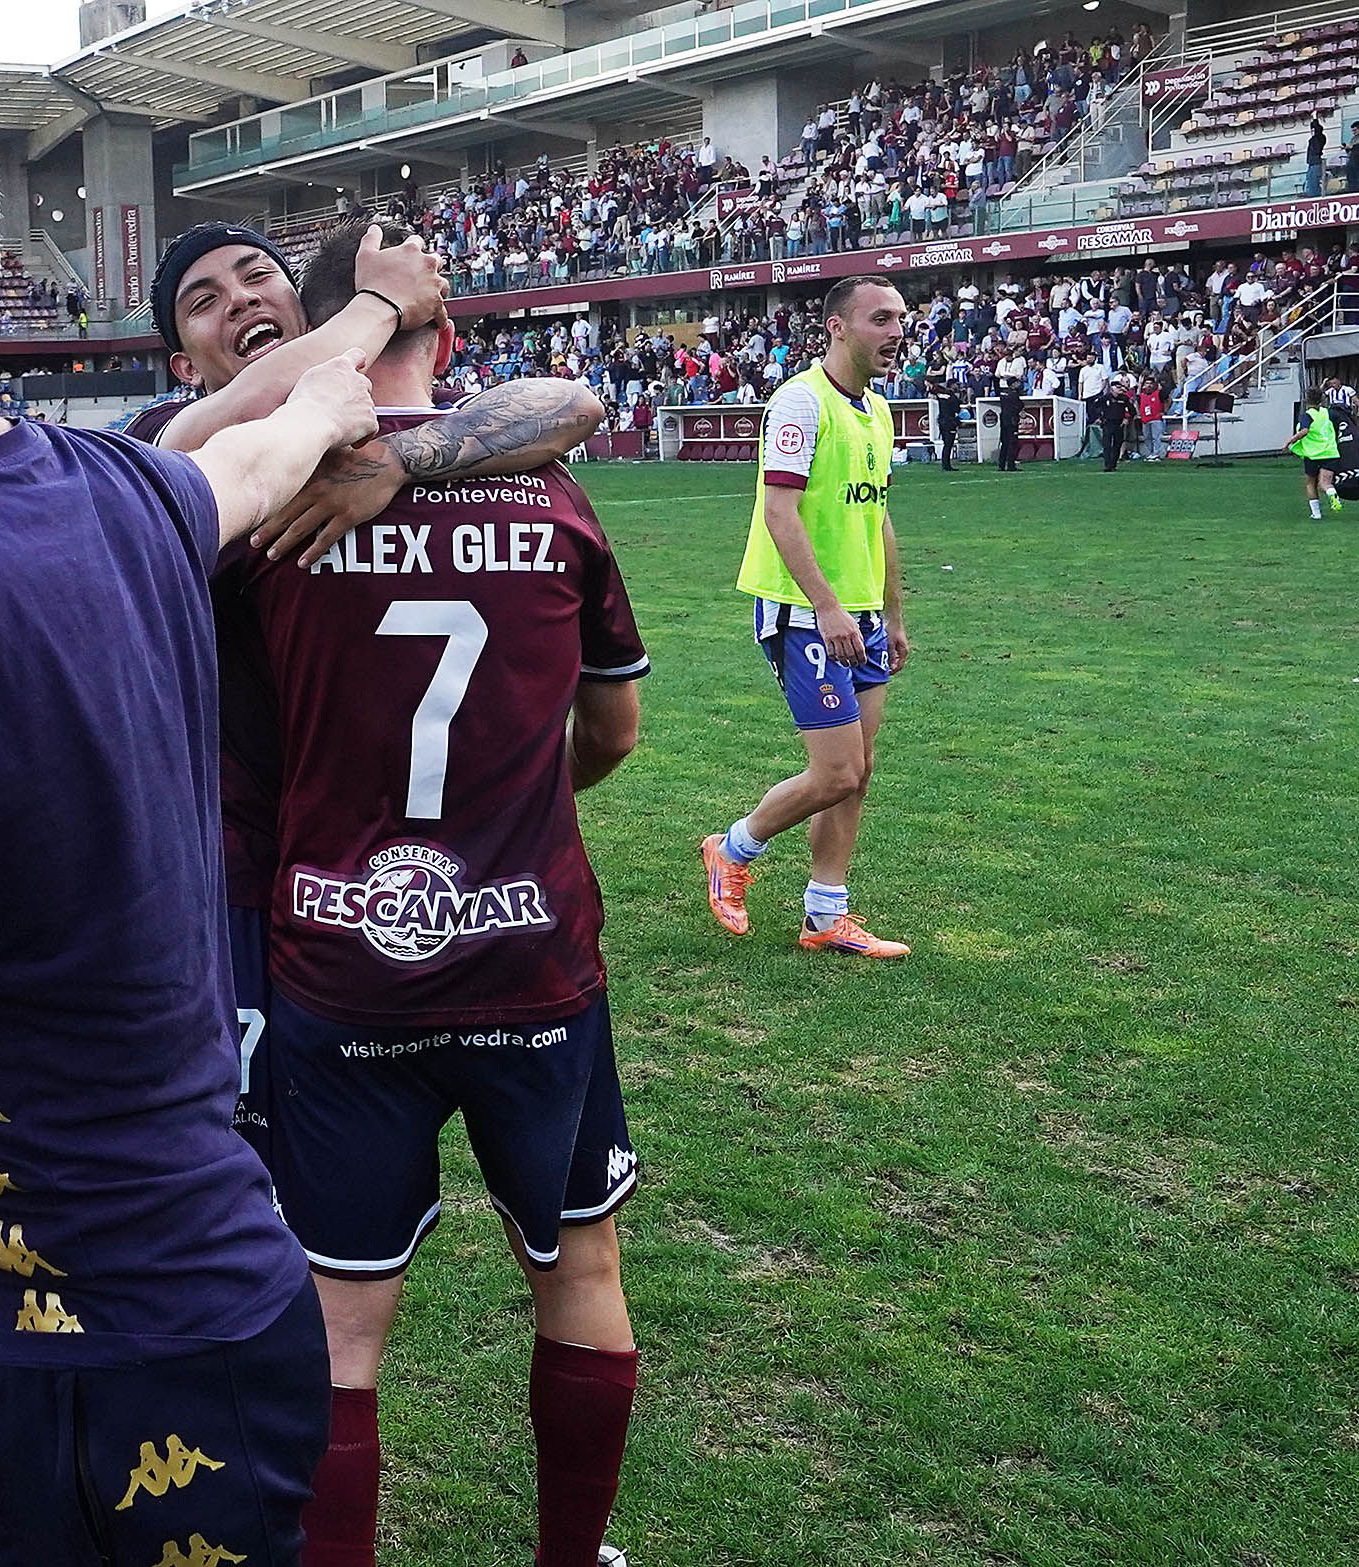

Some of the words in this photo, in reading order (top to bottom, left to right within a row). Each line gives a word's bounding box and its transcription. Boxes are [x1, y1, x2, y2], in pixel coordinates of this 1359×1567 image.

[126, 209, 139, 266] Pontevedra
[1077, 228, 1154, 249] PESCAMAR
[910, 248, 974, 268] PESCAMAR
[128, 276, 140, 307] Diario
[412, 486, 552, 508] Pontevedra
[311, 524, 433, 574] ALEX
[451, 523, 566, 573] GLEZ.
[804, 642, 827, 680] 9
[374, 600, 489, 820] 7
[368, 844, 459, 877] CONSERVAS
[293, 870, 552, 937] PESCAMAR
